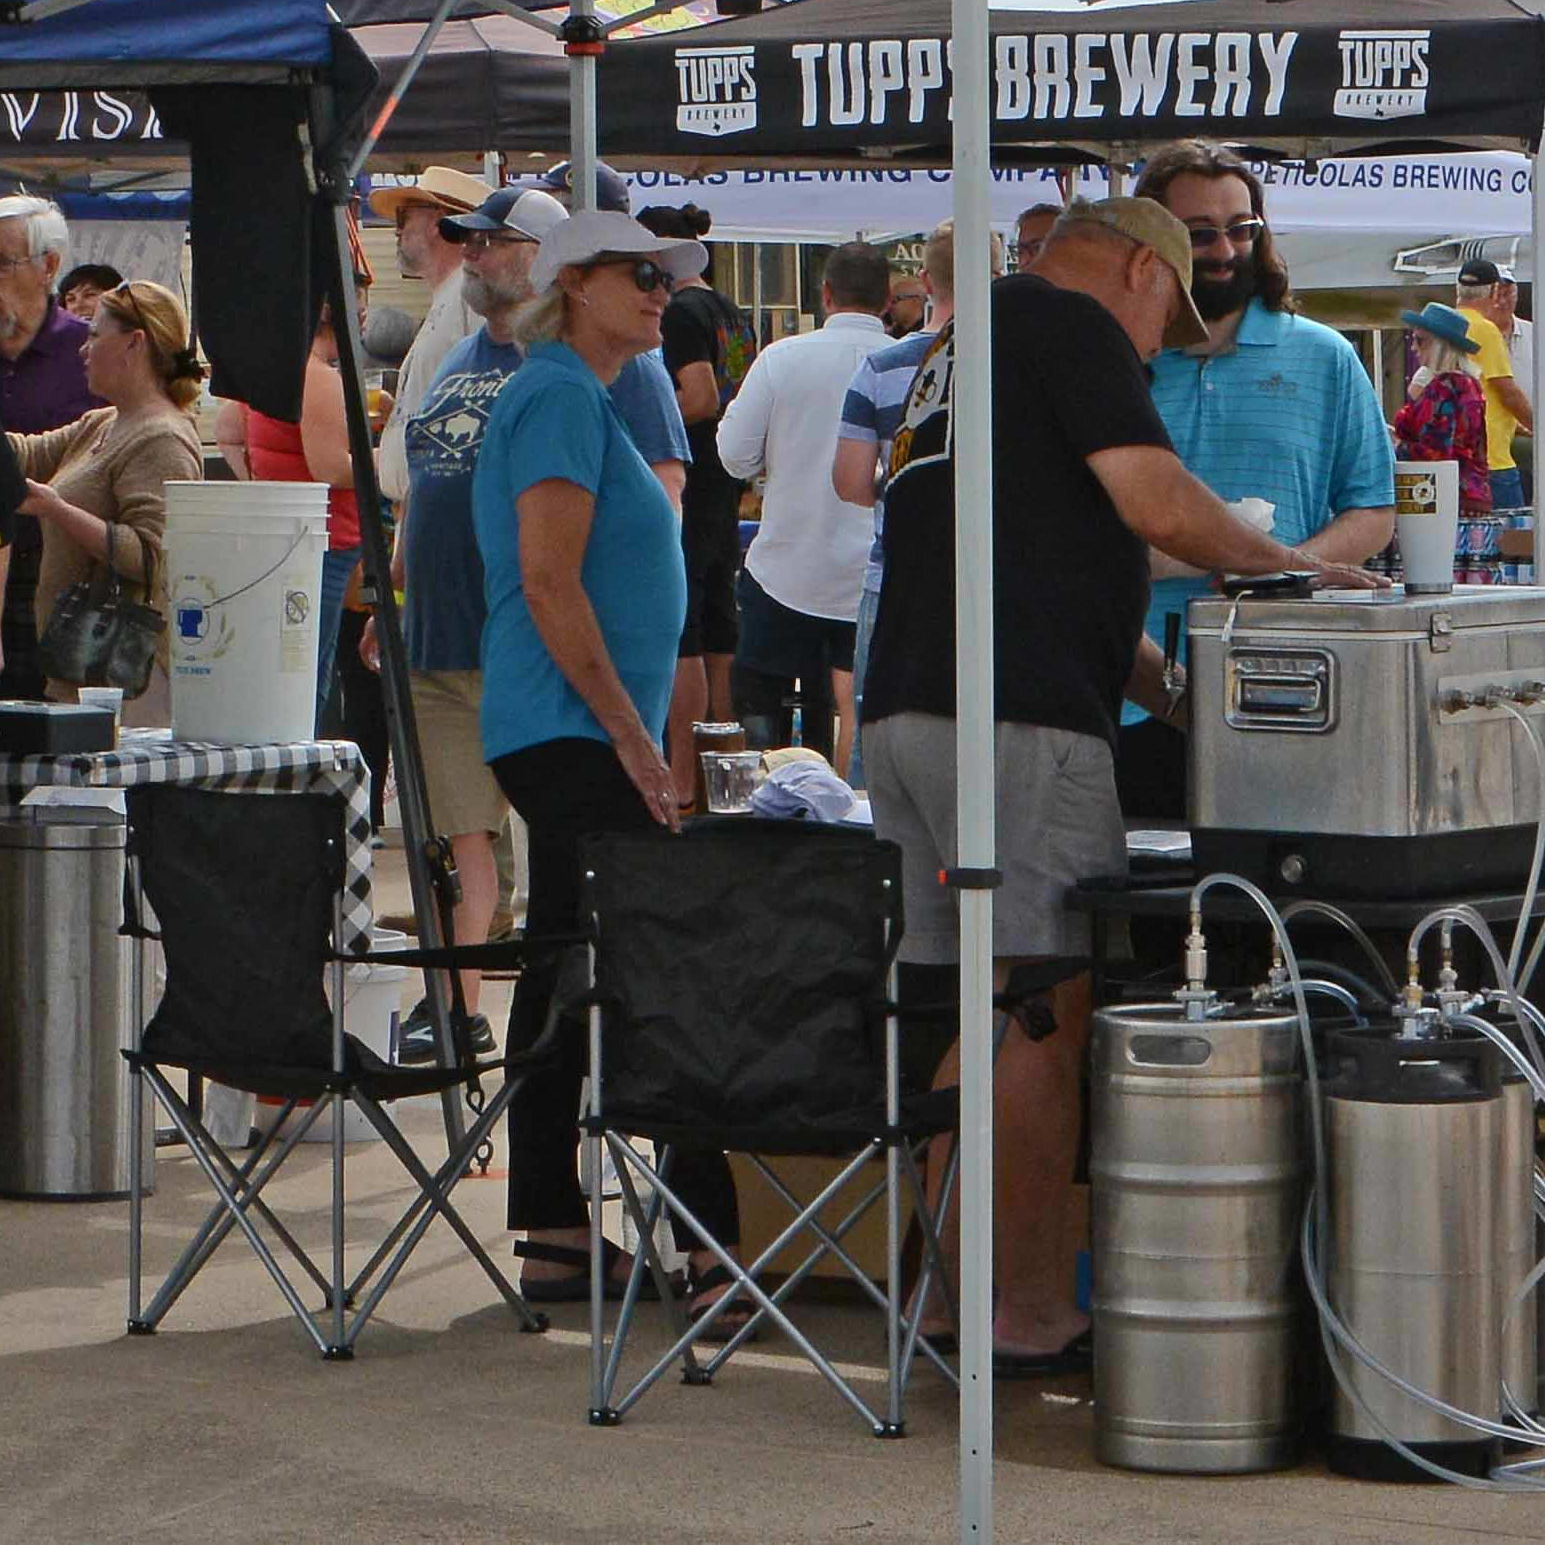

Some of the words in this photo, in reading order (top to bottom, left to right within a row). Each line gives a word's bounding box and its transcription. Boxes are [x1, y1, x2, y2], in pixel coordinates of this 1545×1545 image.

[675, 56, 757, 102] TUPPS
[995, 31, 1298, 119] BREWERY
[1338, 40, 1429, 87] TUPPS
[687, 107, 747, 121] BREWERY
[1346, 94, 1413, 106] BREWERY
[1392, 164, 1503, 192] BREWING
